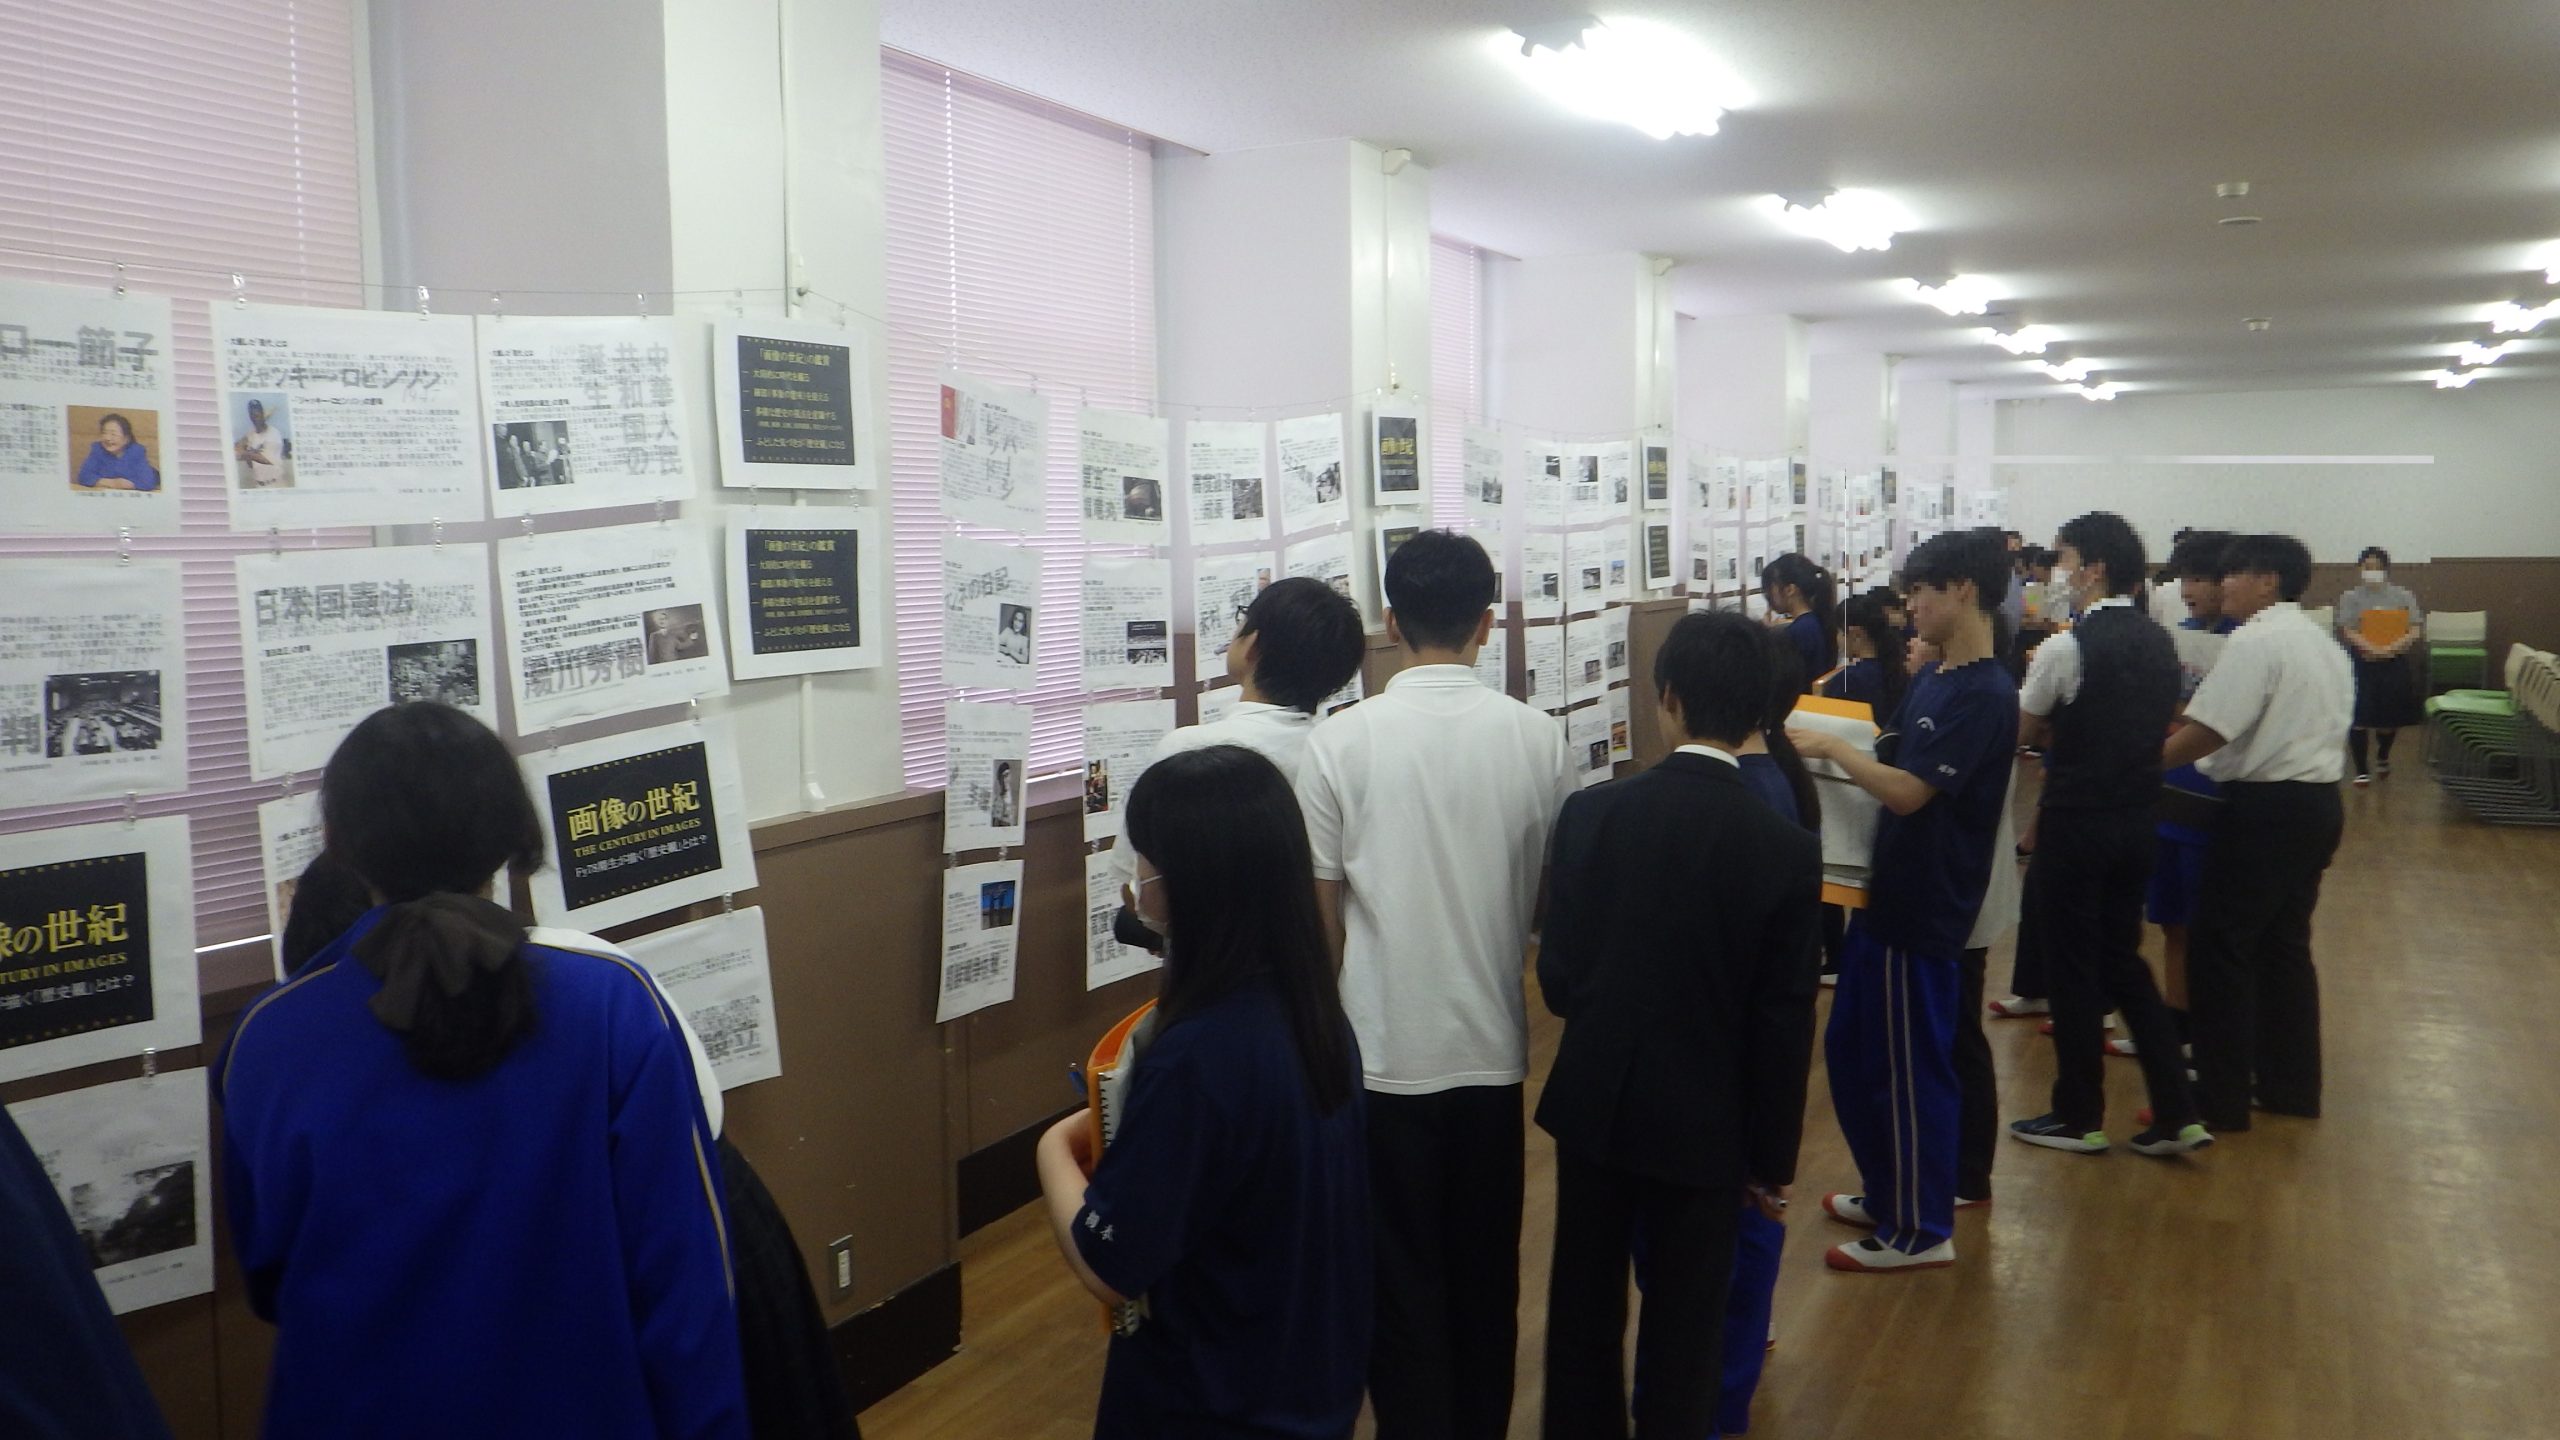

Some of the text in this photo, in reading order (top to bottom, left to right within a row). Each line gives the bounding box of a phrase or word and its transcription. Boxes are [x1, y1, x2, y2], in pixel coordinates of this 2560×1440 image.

[567, 780, 701, 841] 画像の世紀
[573, 846, 597, 858] THE
[599, 829, 650, 851] CENTURY
[661, 817, 702, 835] IMAGES
[63, 952, 128, 973] IMAGES
